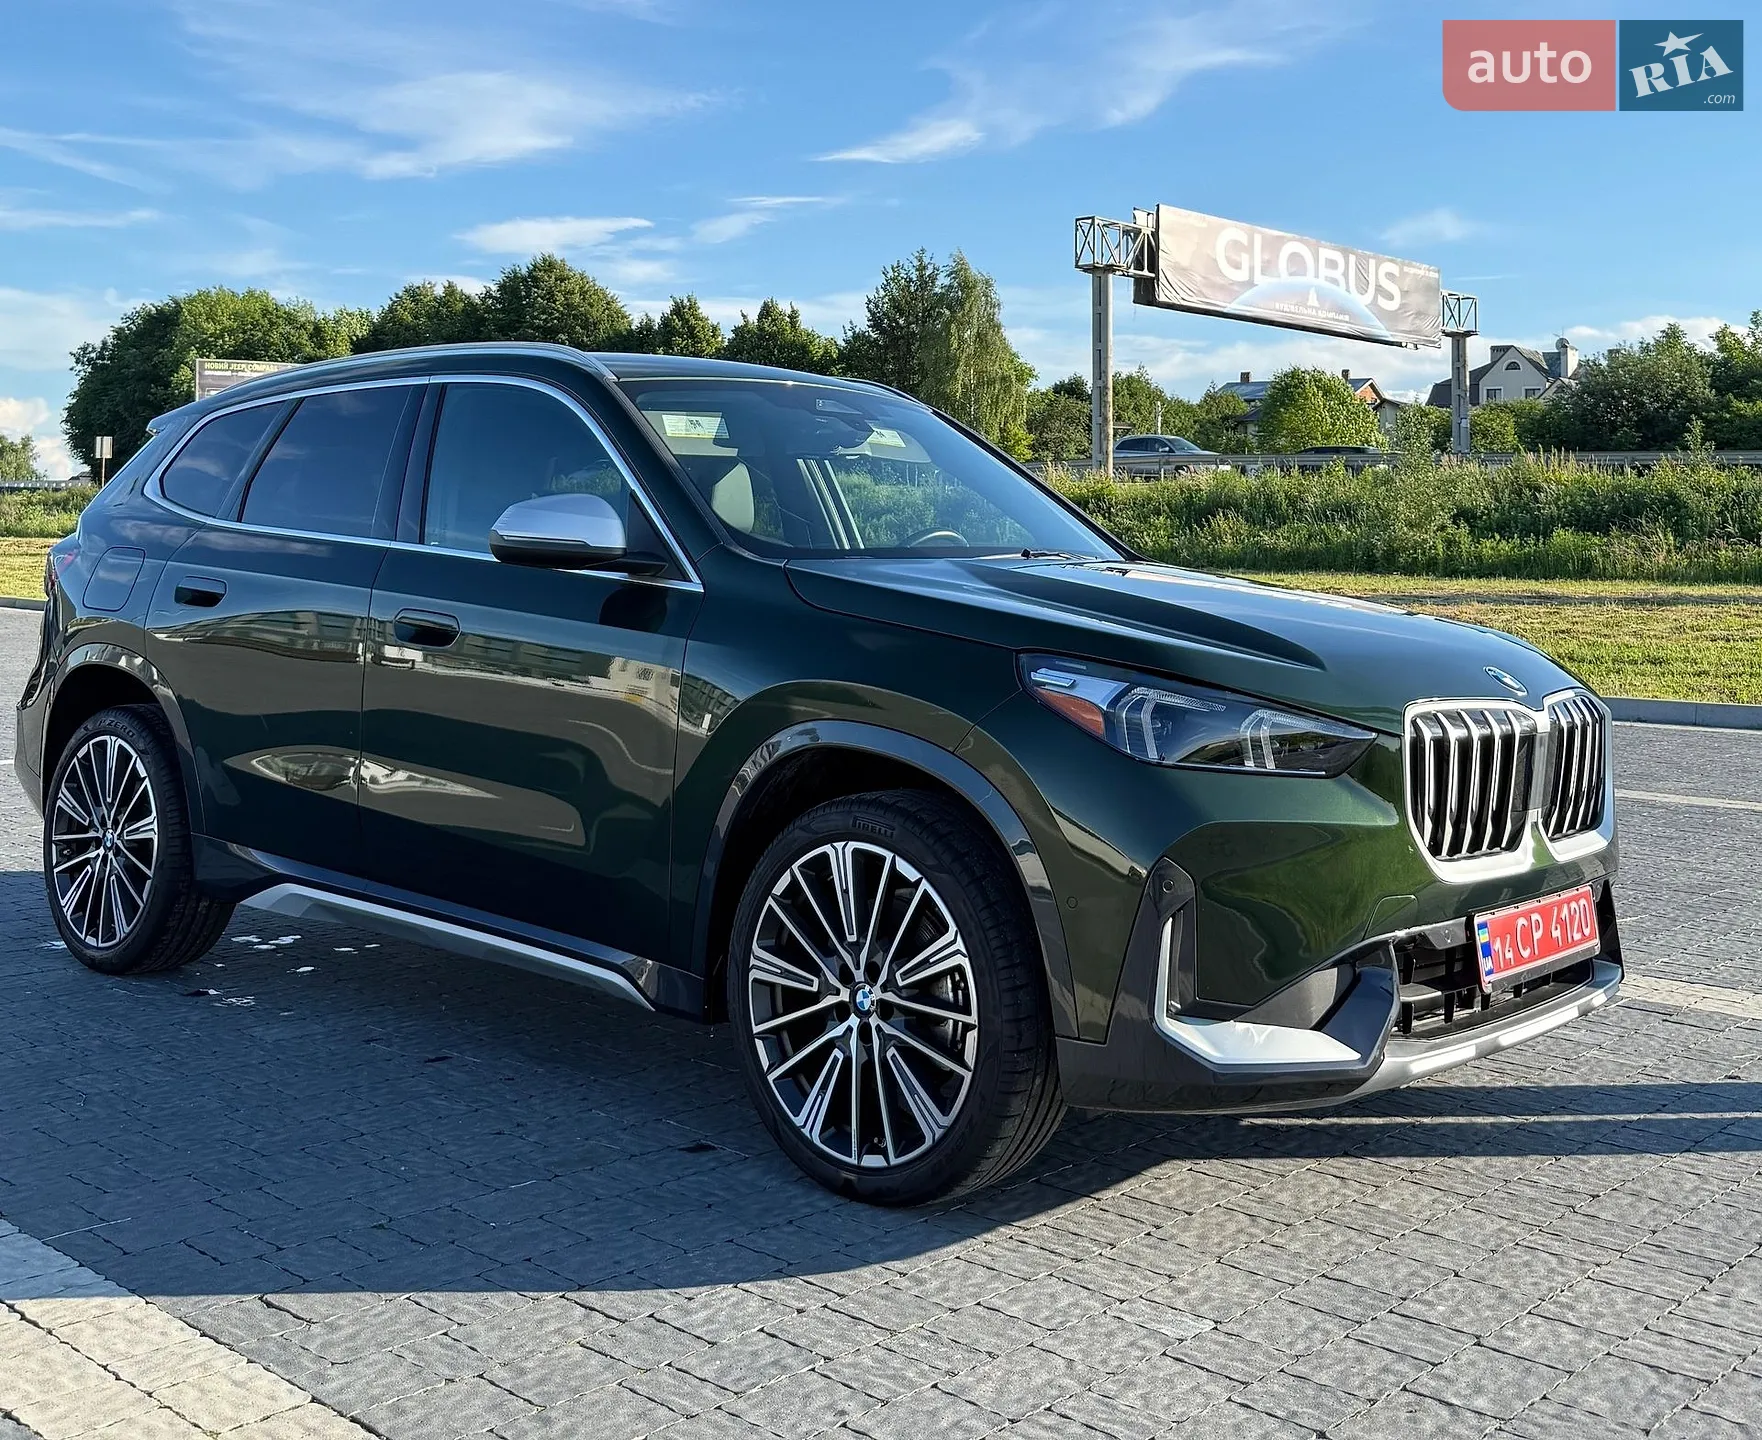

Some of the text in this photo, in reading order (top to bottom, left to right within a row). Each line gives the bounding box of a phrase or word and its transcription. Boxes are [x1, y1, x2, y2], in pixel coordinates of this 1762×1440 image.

[1215, 226, 1402, 311] GLOBUS
[204, 362, 228, 371] НОВИЙ
[107, 719, 136, 738] ZERO
[851, 815, 896, 839] PIRELLI
[1493, 934, 1515, 969] 14
[1550, 898, 1592, 948] 4120
[1482, 956, 1494, 972] UA
